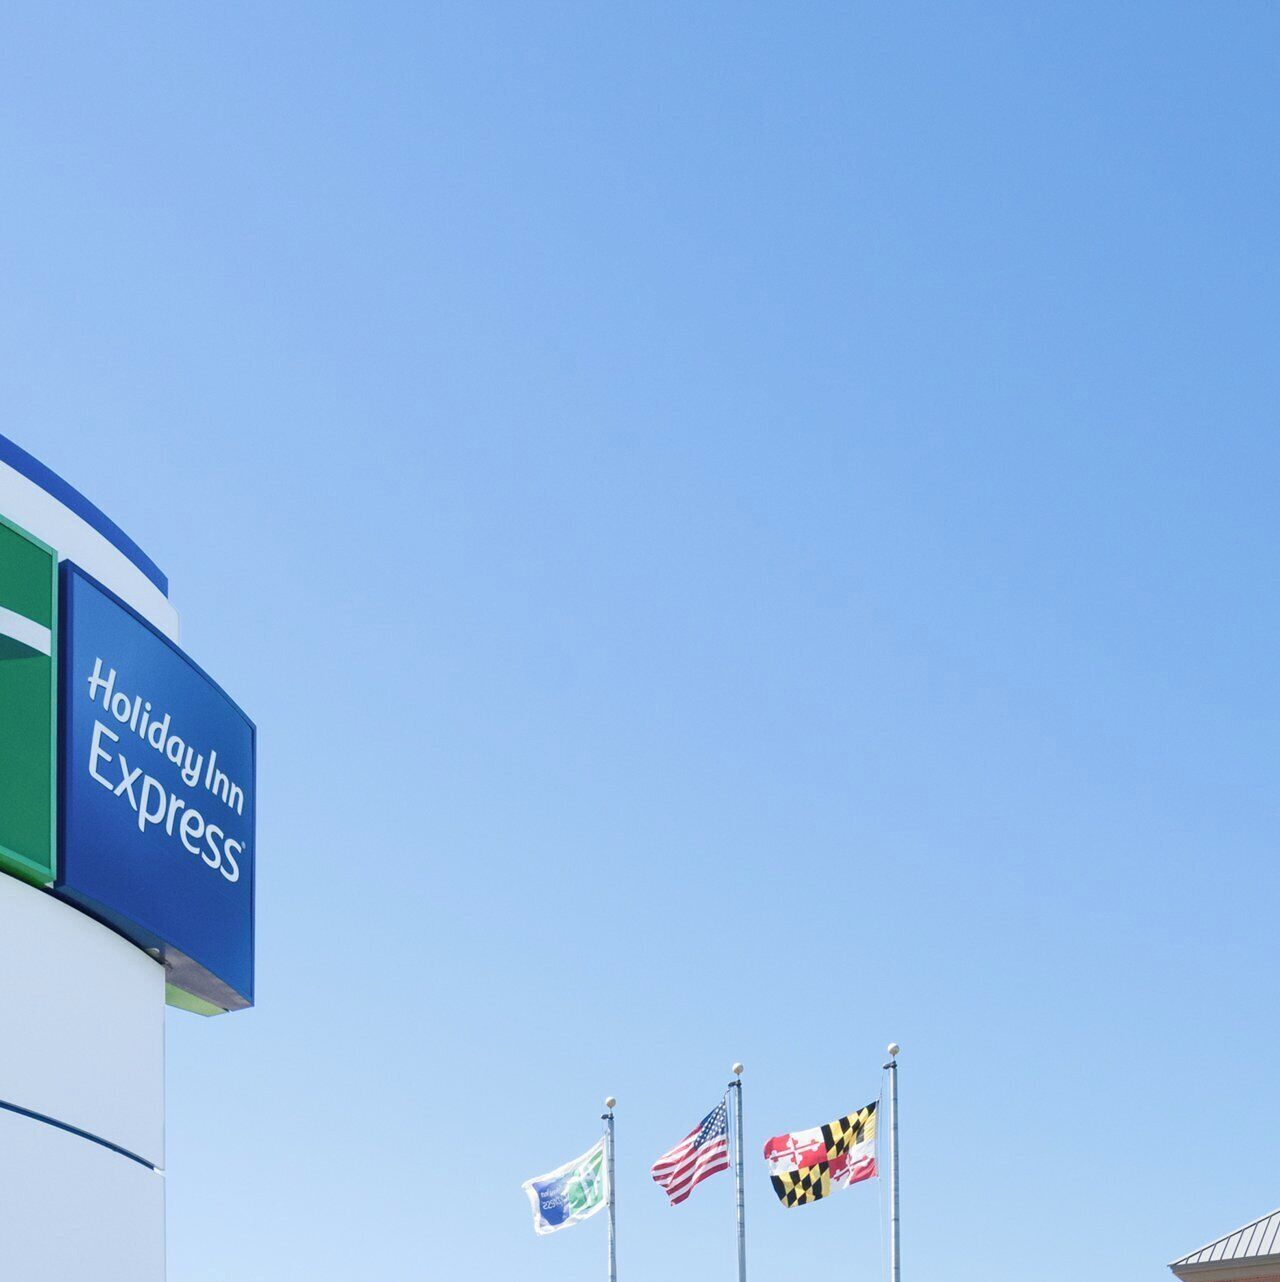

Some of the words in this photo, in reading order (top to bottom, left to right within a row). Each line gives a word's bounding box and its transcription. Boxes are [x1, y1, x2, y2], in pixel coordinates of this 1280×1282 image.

[87, 657, 204, 788] Holiday
[204, 750, 244, 816] Inn
[88, 719, 243, 883] Express
